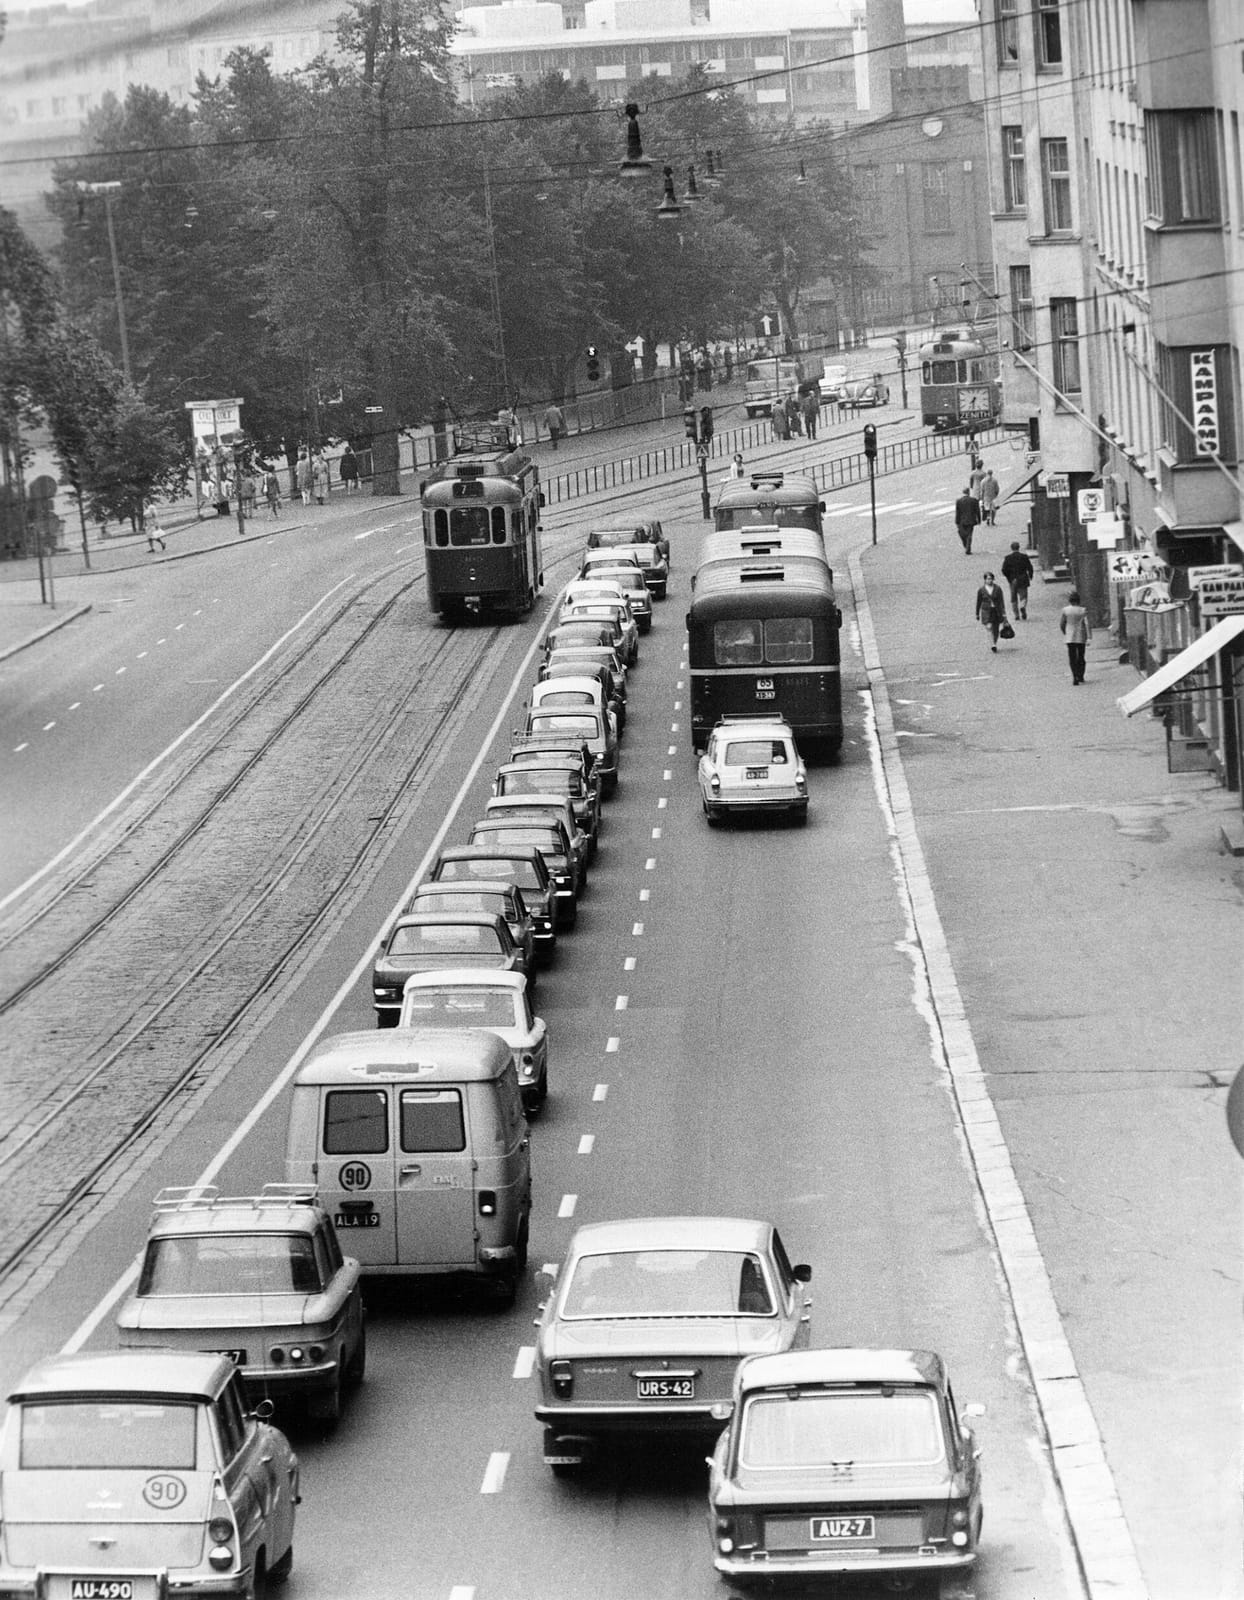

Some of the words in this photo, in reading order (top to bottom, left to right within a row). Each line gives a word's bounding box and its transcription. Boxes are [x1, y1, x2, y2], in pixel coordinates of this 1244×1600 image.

[1193, 354, 1219, 452] KAMPAAMO
[959, 410, 991, 419] ZENITH
[460, 485, 467, 495] 7
[1201, 581, 1244, 593] KAMPAA
[345, 1167, 366, 1186] 90
[640, 1381, 692, 1396] URS-42
[150, 1481, 179, 1501] 90
[819, 1519, 866, 1537] AUZ-7
[73, 1582, 132, 1598] AU-490
